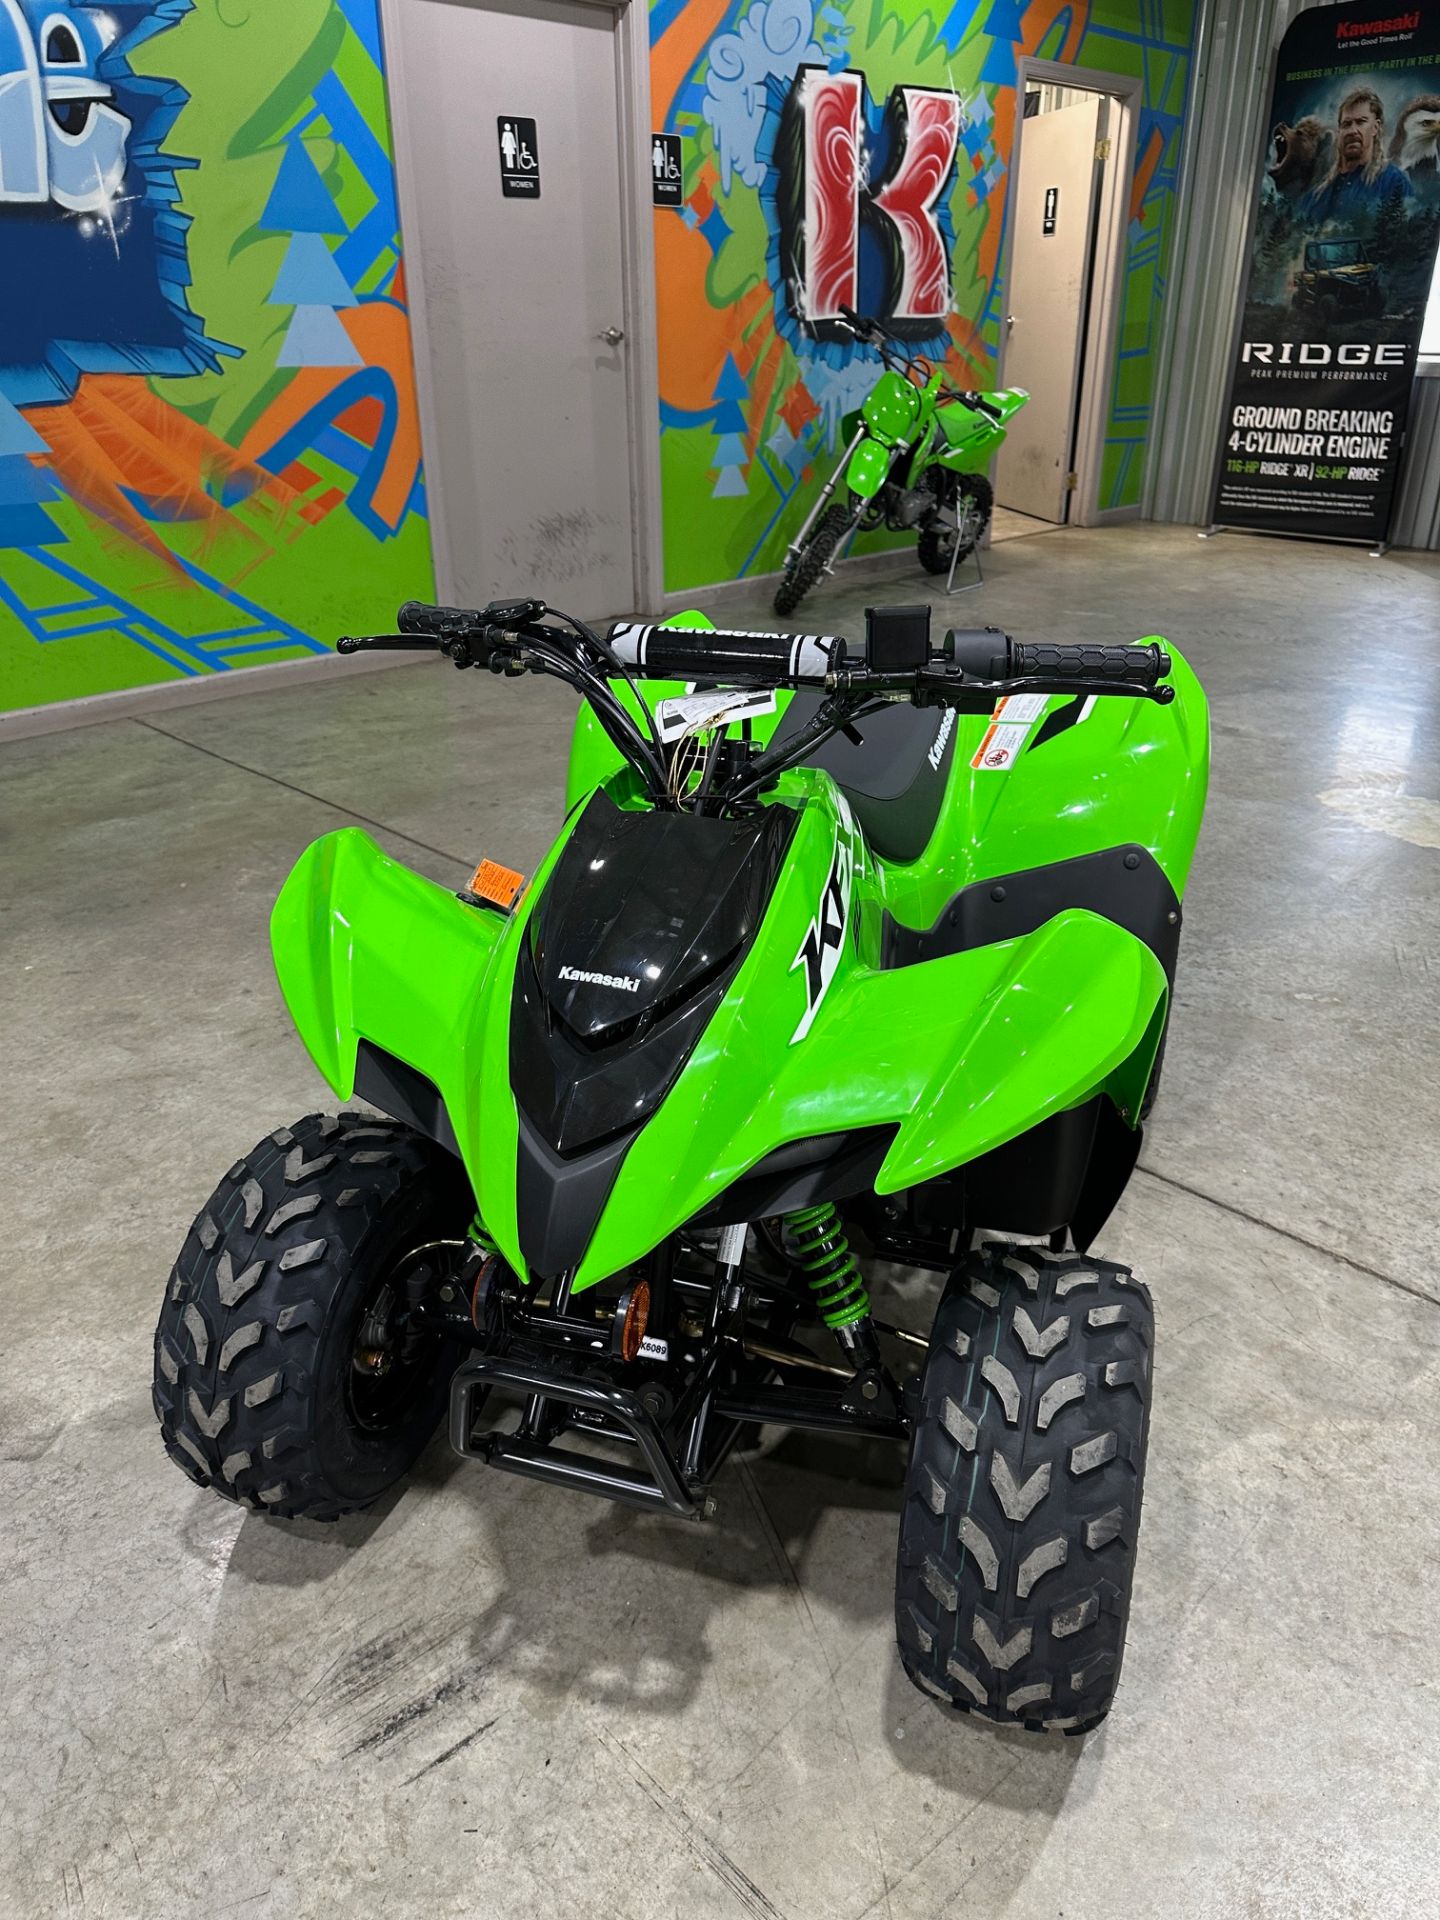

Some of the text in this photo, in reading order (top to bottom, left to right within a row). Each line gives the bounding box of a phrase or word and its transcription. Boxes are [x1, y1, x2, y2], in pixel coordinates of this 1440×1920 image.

[1337, 13, 1419, 37] Kawasaki
[1361, 38, 1377, 46] Good
[1379, 35, 1397, 43] Times
[1286, 69, 1321, 80] BUSINESS
[1324, 67, 1333, 77] IN
[1334, 65, 1348, 75] THE
[1380, 60, 1405, 69] PARTY
[1406, 58, 1416, 66] IN
[1417, 55, 1433, 65] THE
[800, 66, 962, 322] K
[1242, 342, 1407, 365] RIDGE
[1250, 368, 1389, 381] PEAK PREMIUM PERFORMANCE
[1233, 405, 1393, 434] GROUND BREAKING
[1228, 431, 1388, 459] 4-CYLINDER ENGINE
[1227, 459, 1259, 473] 116-HP
[1315, 466, 1348, 480] 92-HP
[928, 707, 956, 771] Kawasa
[558, 966, 640, 992] Kawasaki
[640, 1342, 666, 1354] K6089
